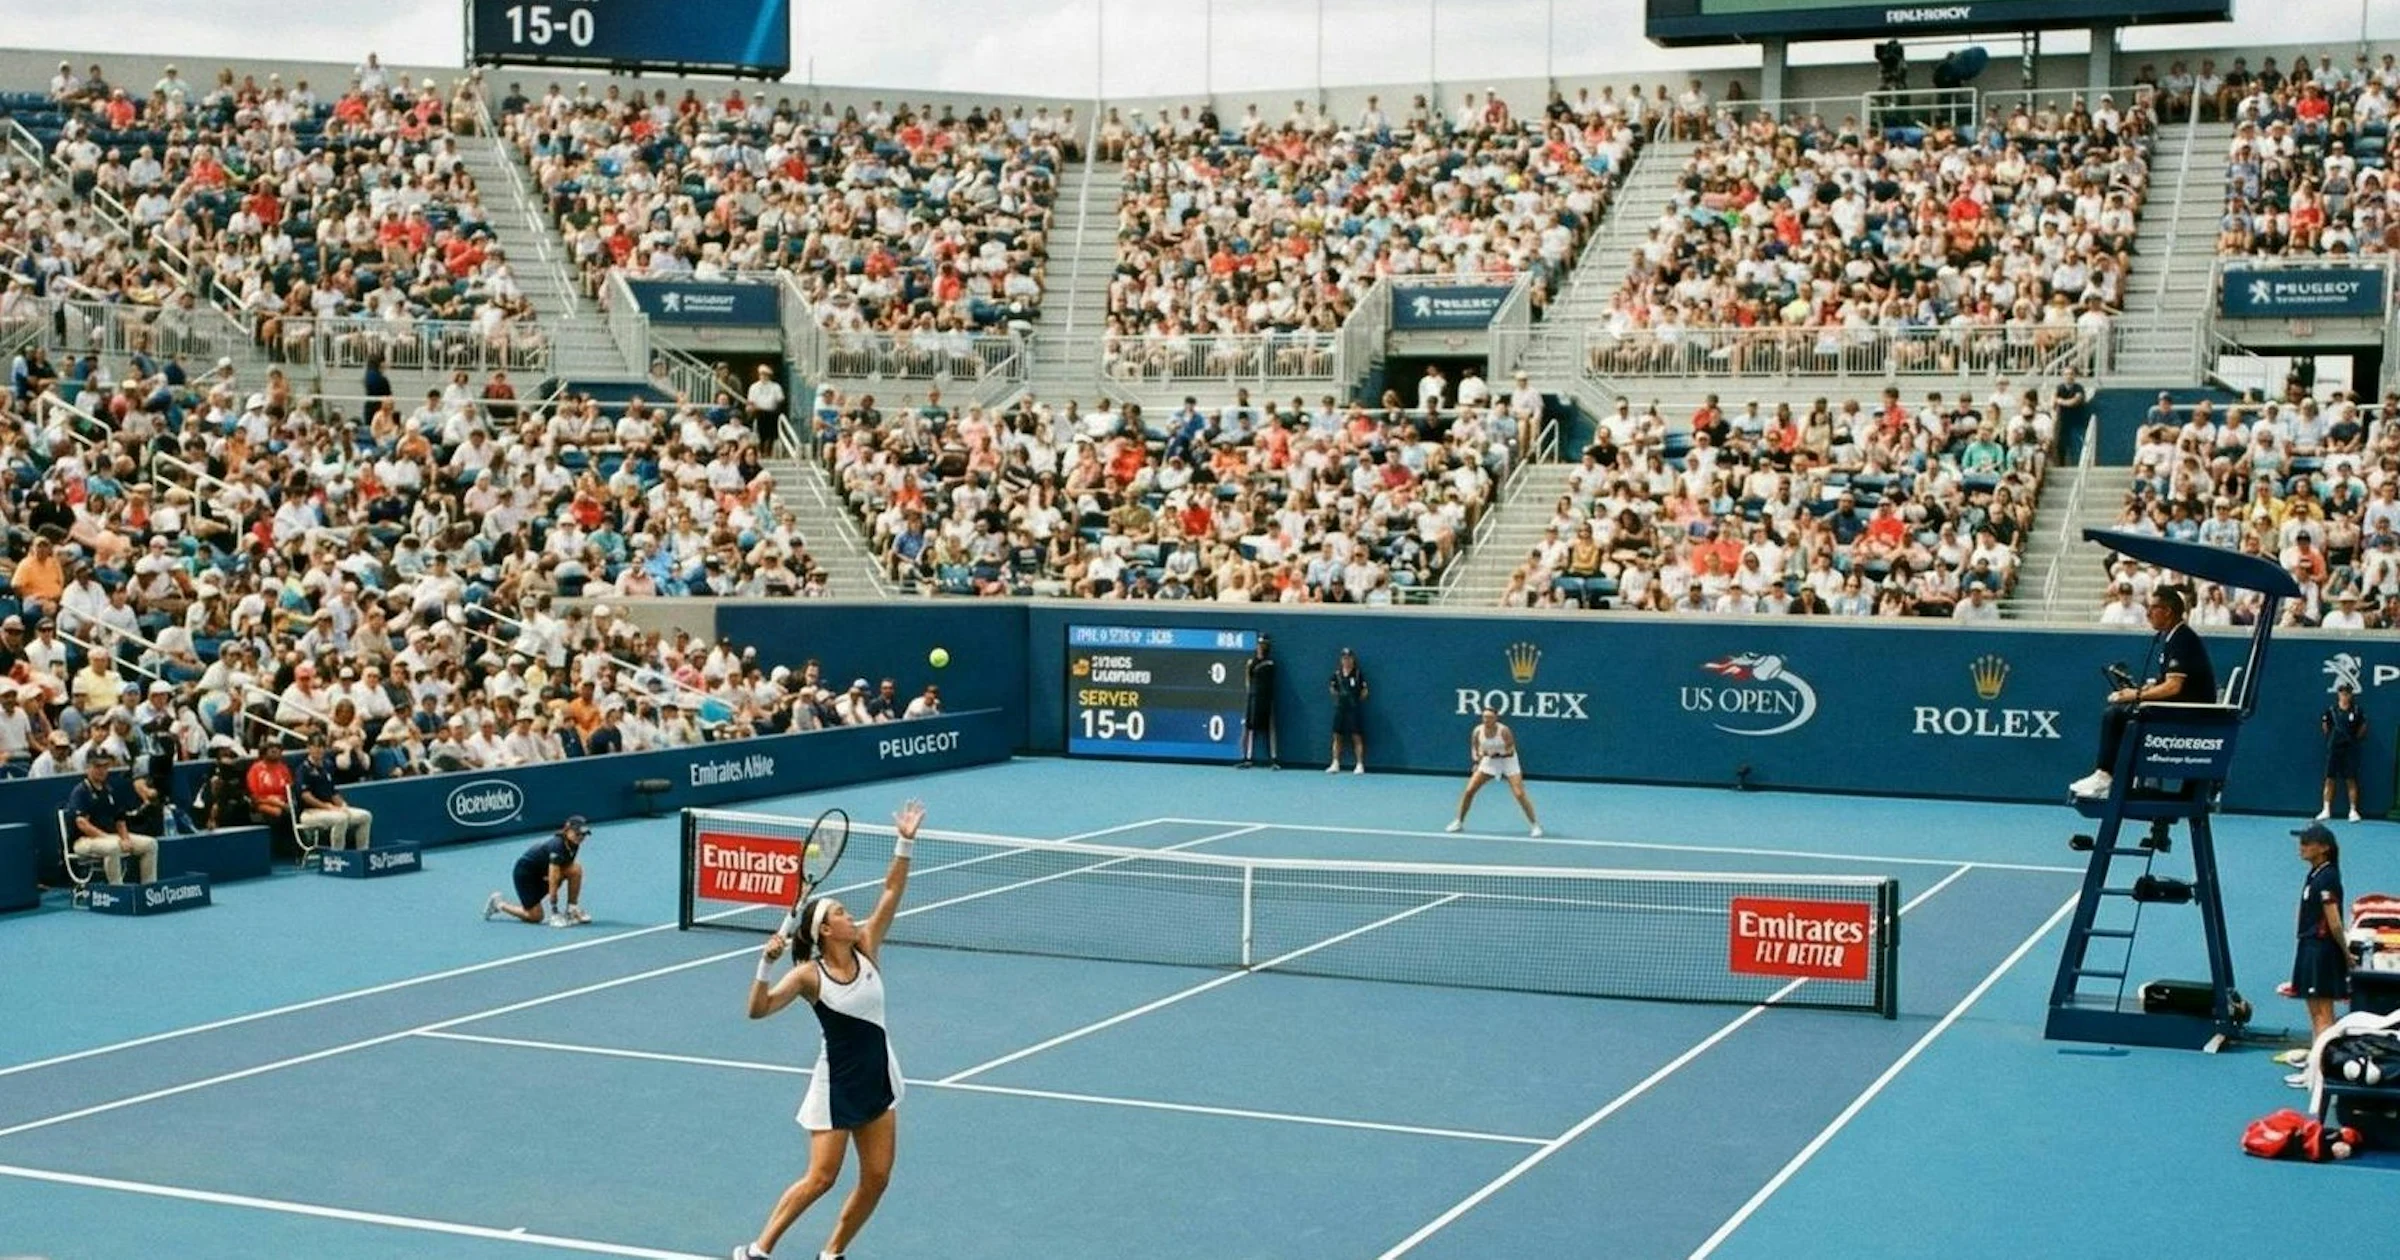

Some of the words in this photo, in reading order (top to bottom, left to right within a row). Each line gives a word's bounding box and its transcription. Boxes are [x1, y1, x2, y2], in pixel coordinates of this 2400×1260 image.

[505, 5, 594, 47] 15-0
[1078, 690, 1140, 707] SERVER
[1455, 688, 1589, 719] ROLEX
[1680, 686, 1713, 711] US
[1719, 687, 1797, 715] OPEN
[1080, 709, 1145, 741] 15-0
[1912, 706, 2062, 739] ROLEX
[879, 731, 960, 760] PEUGEOT
[703, 843, 799, 874] Emirates
[1738, 910, 1864, 943] Emirates
[1755, 940, 1784, 964] FLY
